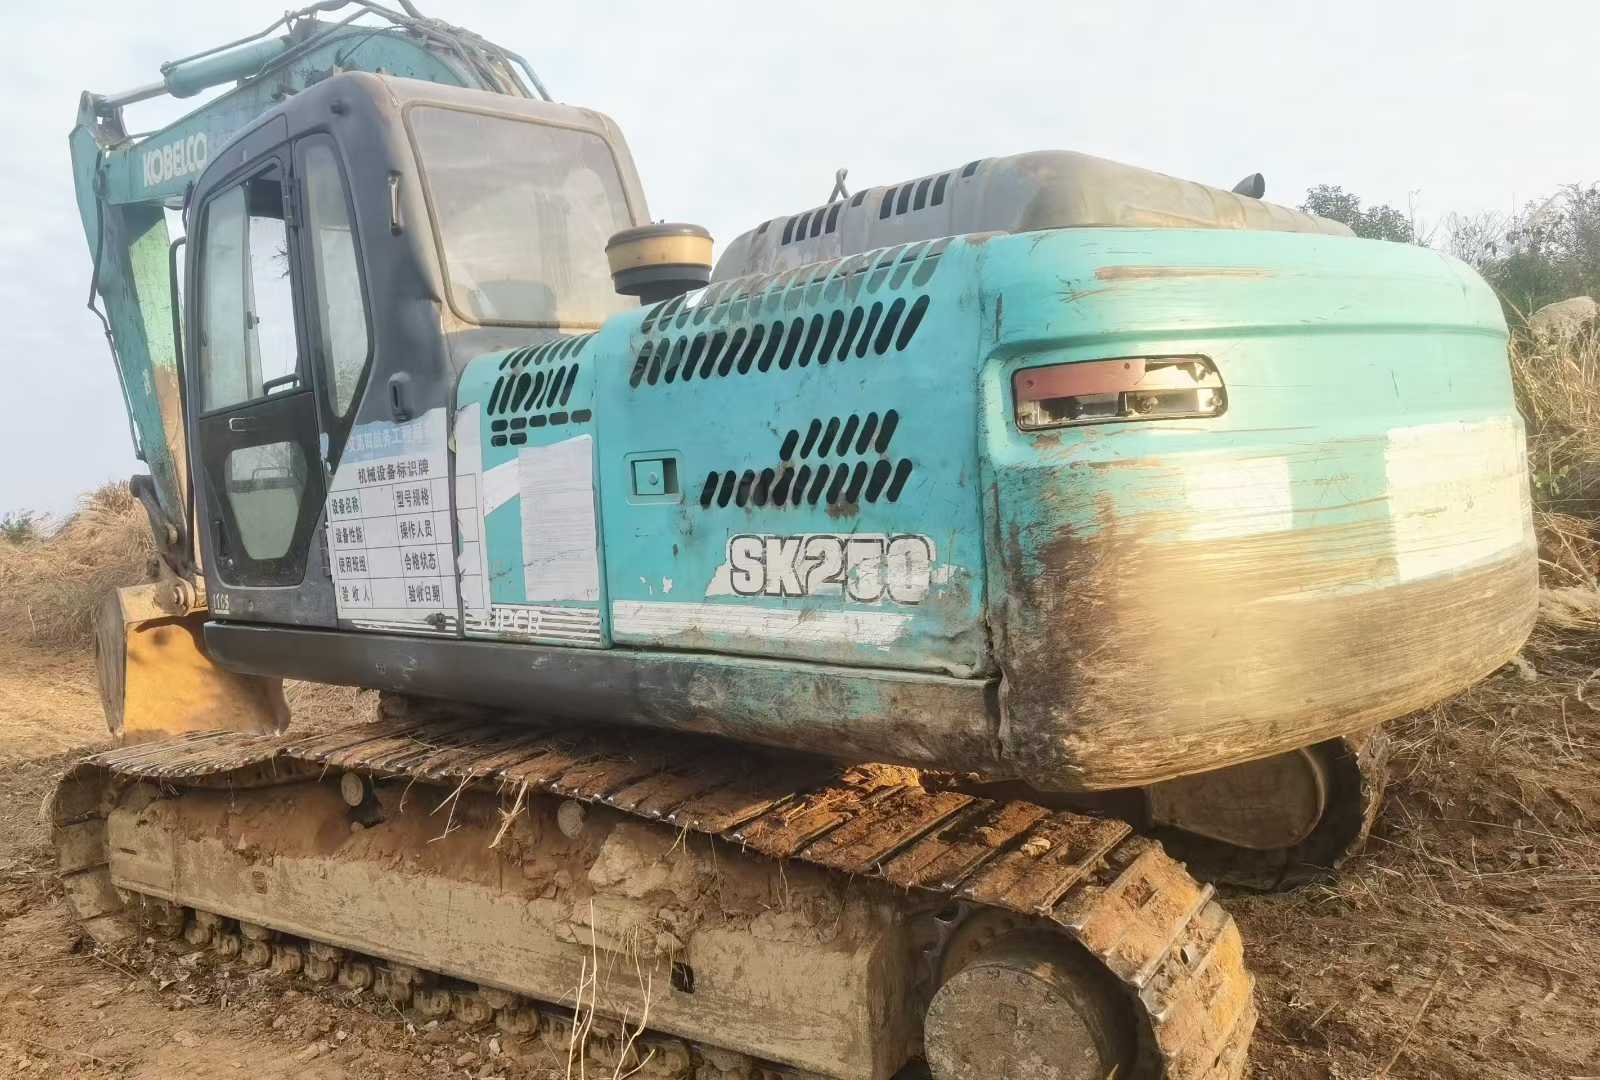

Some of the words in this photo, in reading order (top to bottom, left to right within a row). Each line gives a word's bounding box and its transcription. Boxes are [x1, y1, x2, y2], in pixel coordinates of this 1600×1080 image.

[144, 131, 207, 187] KOBELCO
[358, 459, 429, 484] 机械设备标识牌
[332, 495, 359, 515] 设备名称
[396, 488, 429, 508] 型号规格
[335, 526, 364, 544] 设备性能
[400, 519, 433, 539] 操作人员
[404, 551, 436, 571] 合格状态
[408, 584, 441, 603] 验收日期
